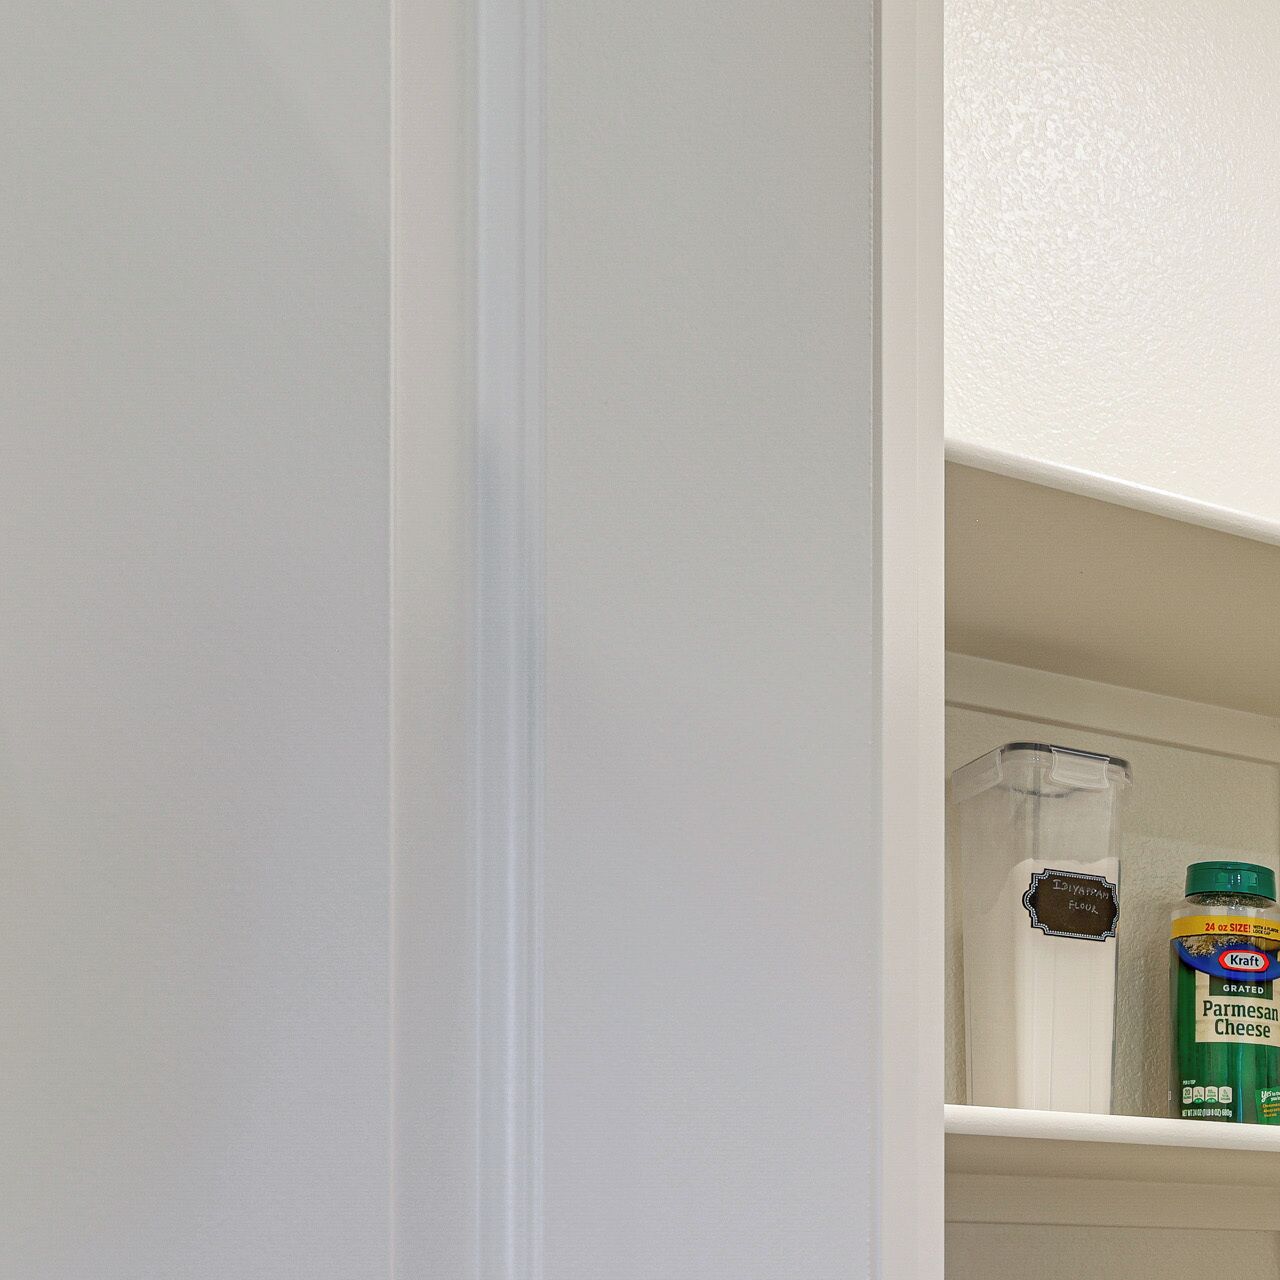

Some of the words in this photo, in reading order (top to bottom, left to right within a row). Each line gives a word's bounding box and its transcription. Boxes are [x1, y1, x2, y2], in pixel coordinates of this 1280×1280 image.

[1068, 900, 1099, 915] FLOUR
[1205, 923, 1215, 932] 24
[1218, 924, 1228, 932] oz
[1229, 923, 1251, 933] SIZE!
[1230, 954, 1259, 967] Kraft
[1222, 984, 1264, 995] GRATED
[1202, 1000, 1279, 1021] Parmesan
[1214, 1018, 1271, 1038] Cheese
